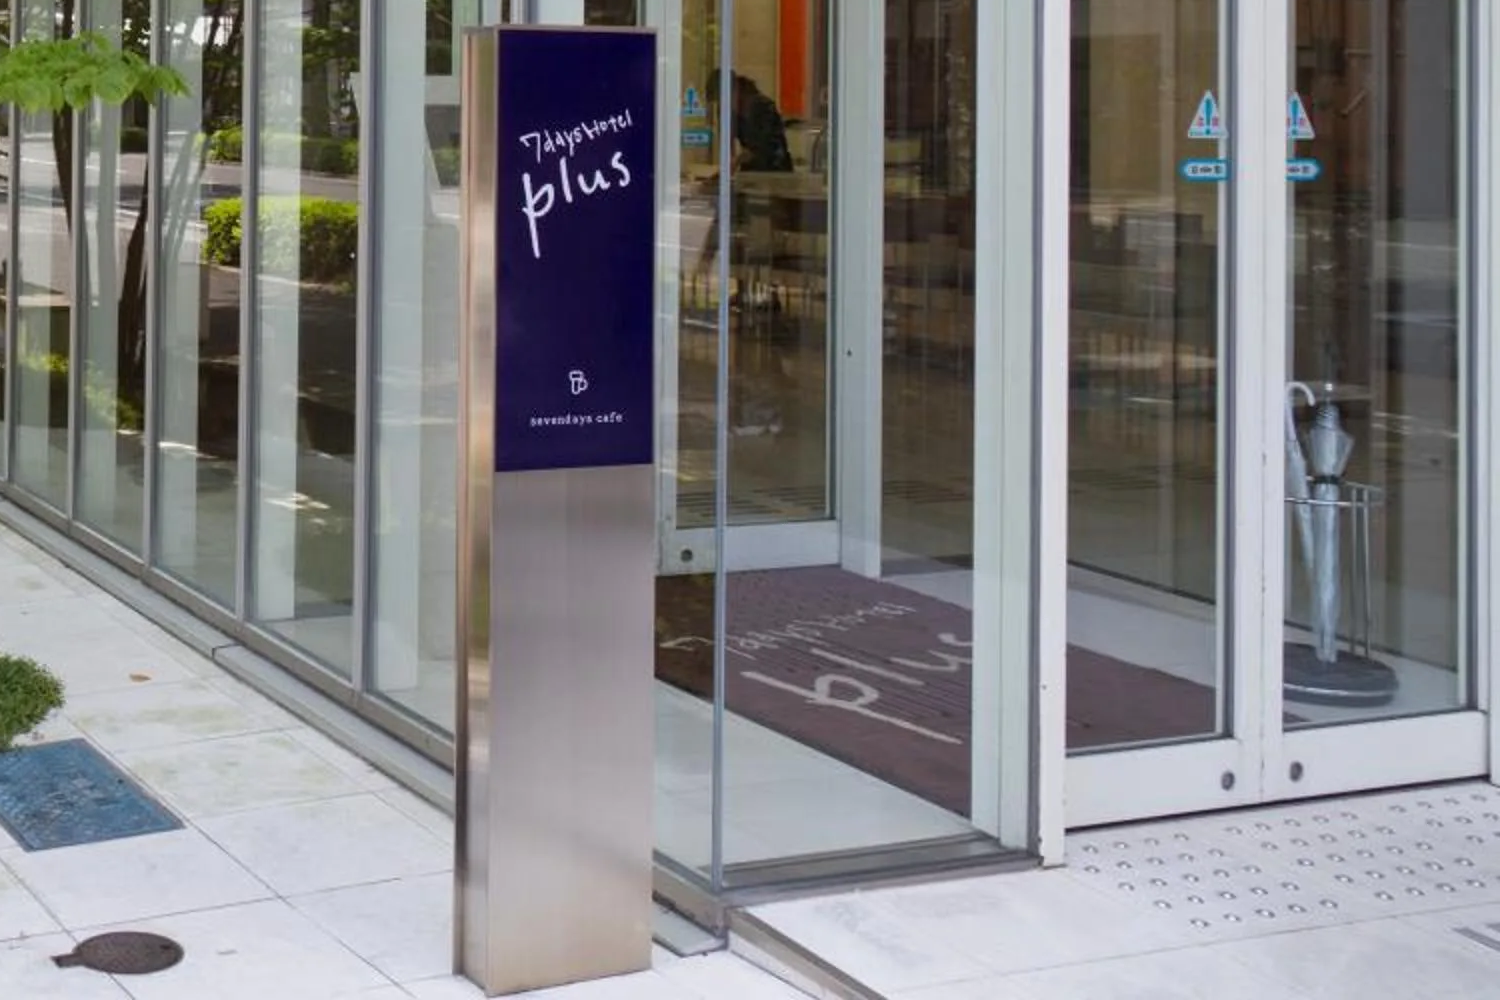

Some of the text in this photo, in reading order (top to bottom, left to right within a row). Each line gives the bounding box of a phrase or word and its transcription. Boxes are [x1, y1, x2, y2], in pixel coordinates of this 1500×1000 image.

[521, 151, 632, 259] plus
[530, 411, 624, 427] sevendays cafe
